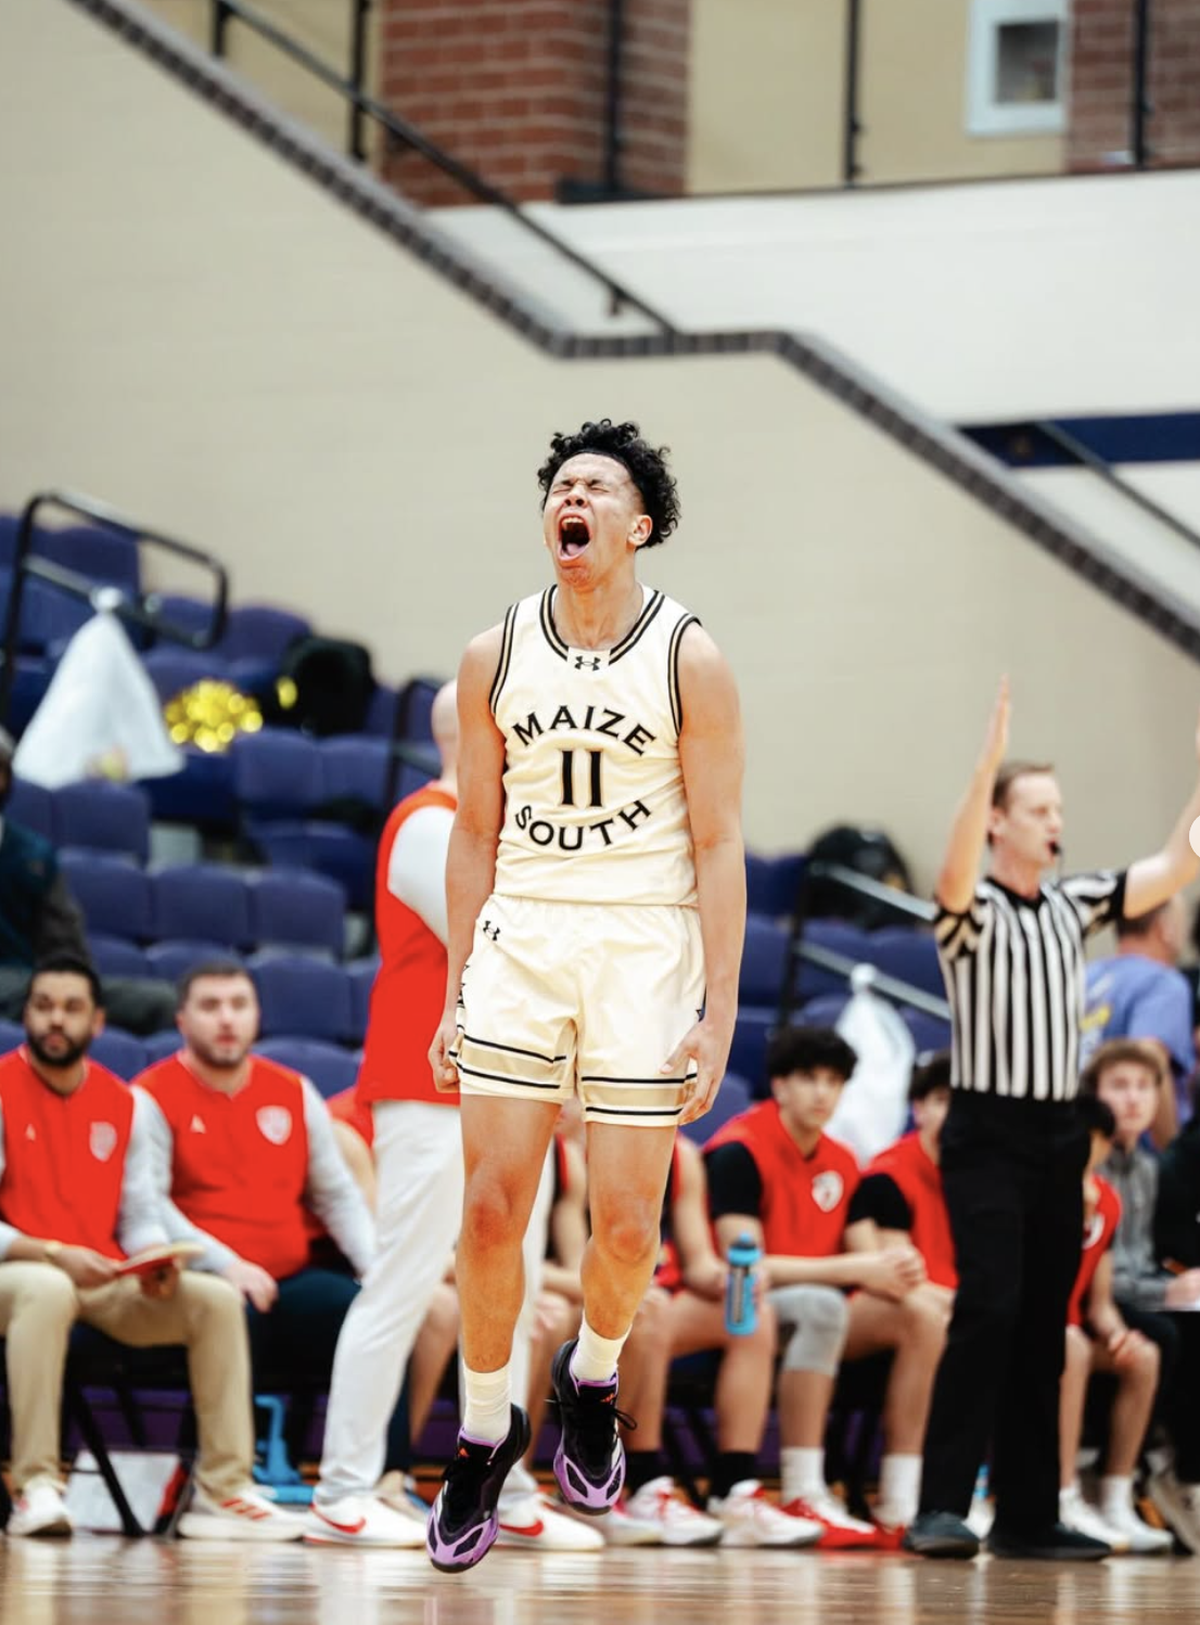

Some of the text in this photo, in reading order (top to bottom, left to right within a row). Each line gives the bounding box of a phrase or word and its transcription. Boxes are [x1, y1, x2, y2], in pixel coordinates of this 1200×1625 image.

[512, 705, 657, 756] MAIZE
[560, 749, 604, 808] 11
[515, 800, 652, 851] SOUTH
